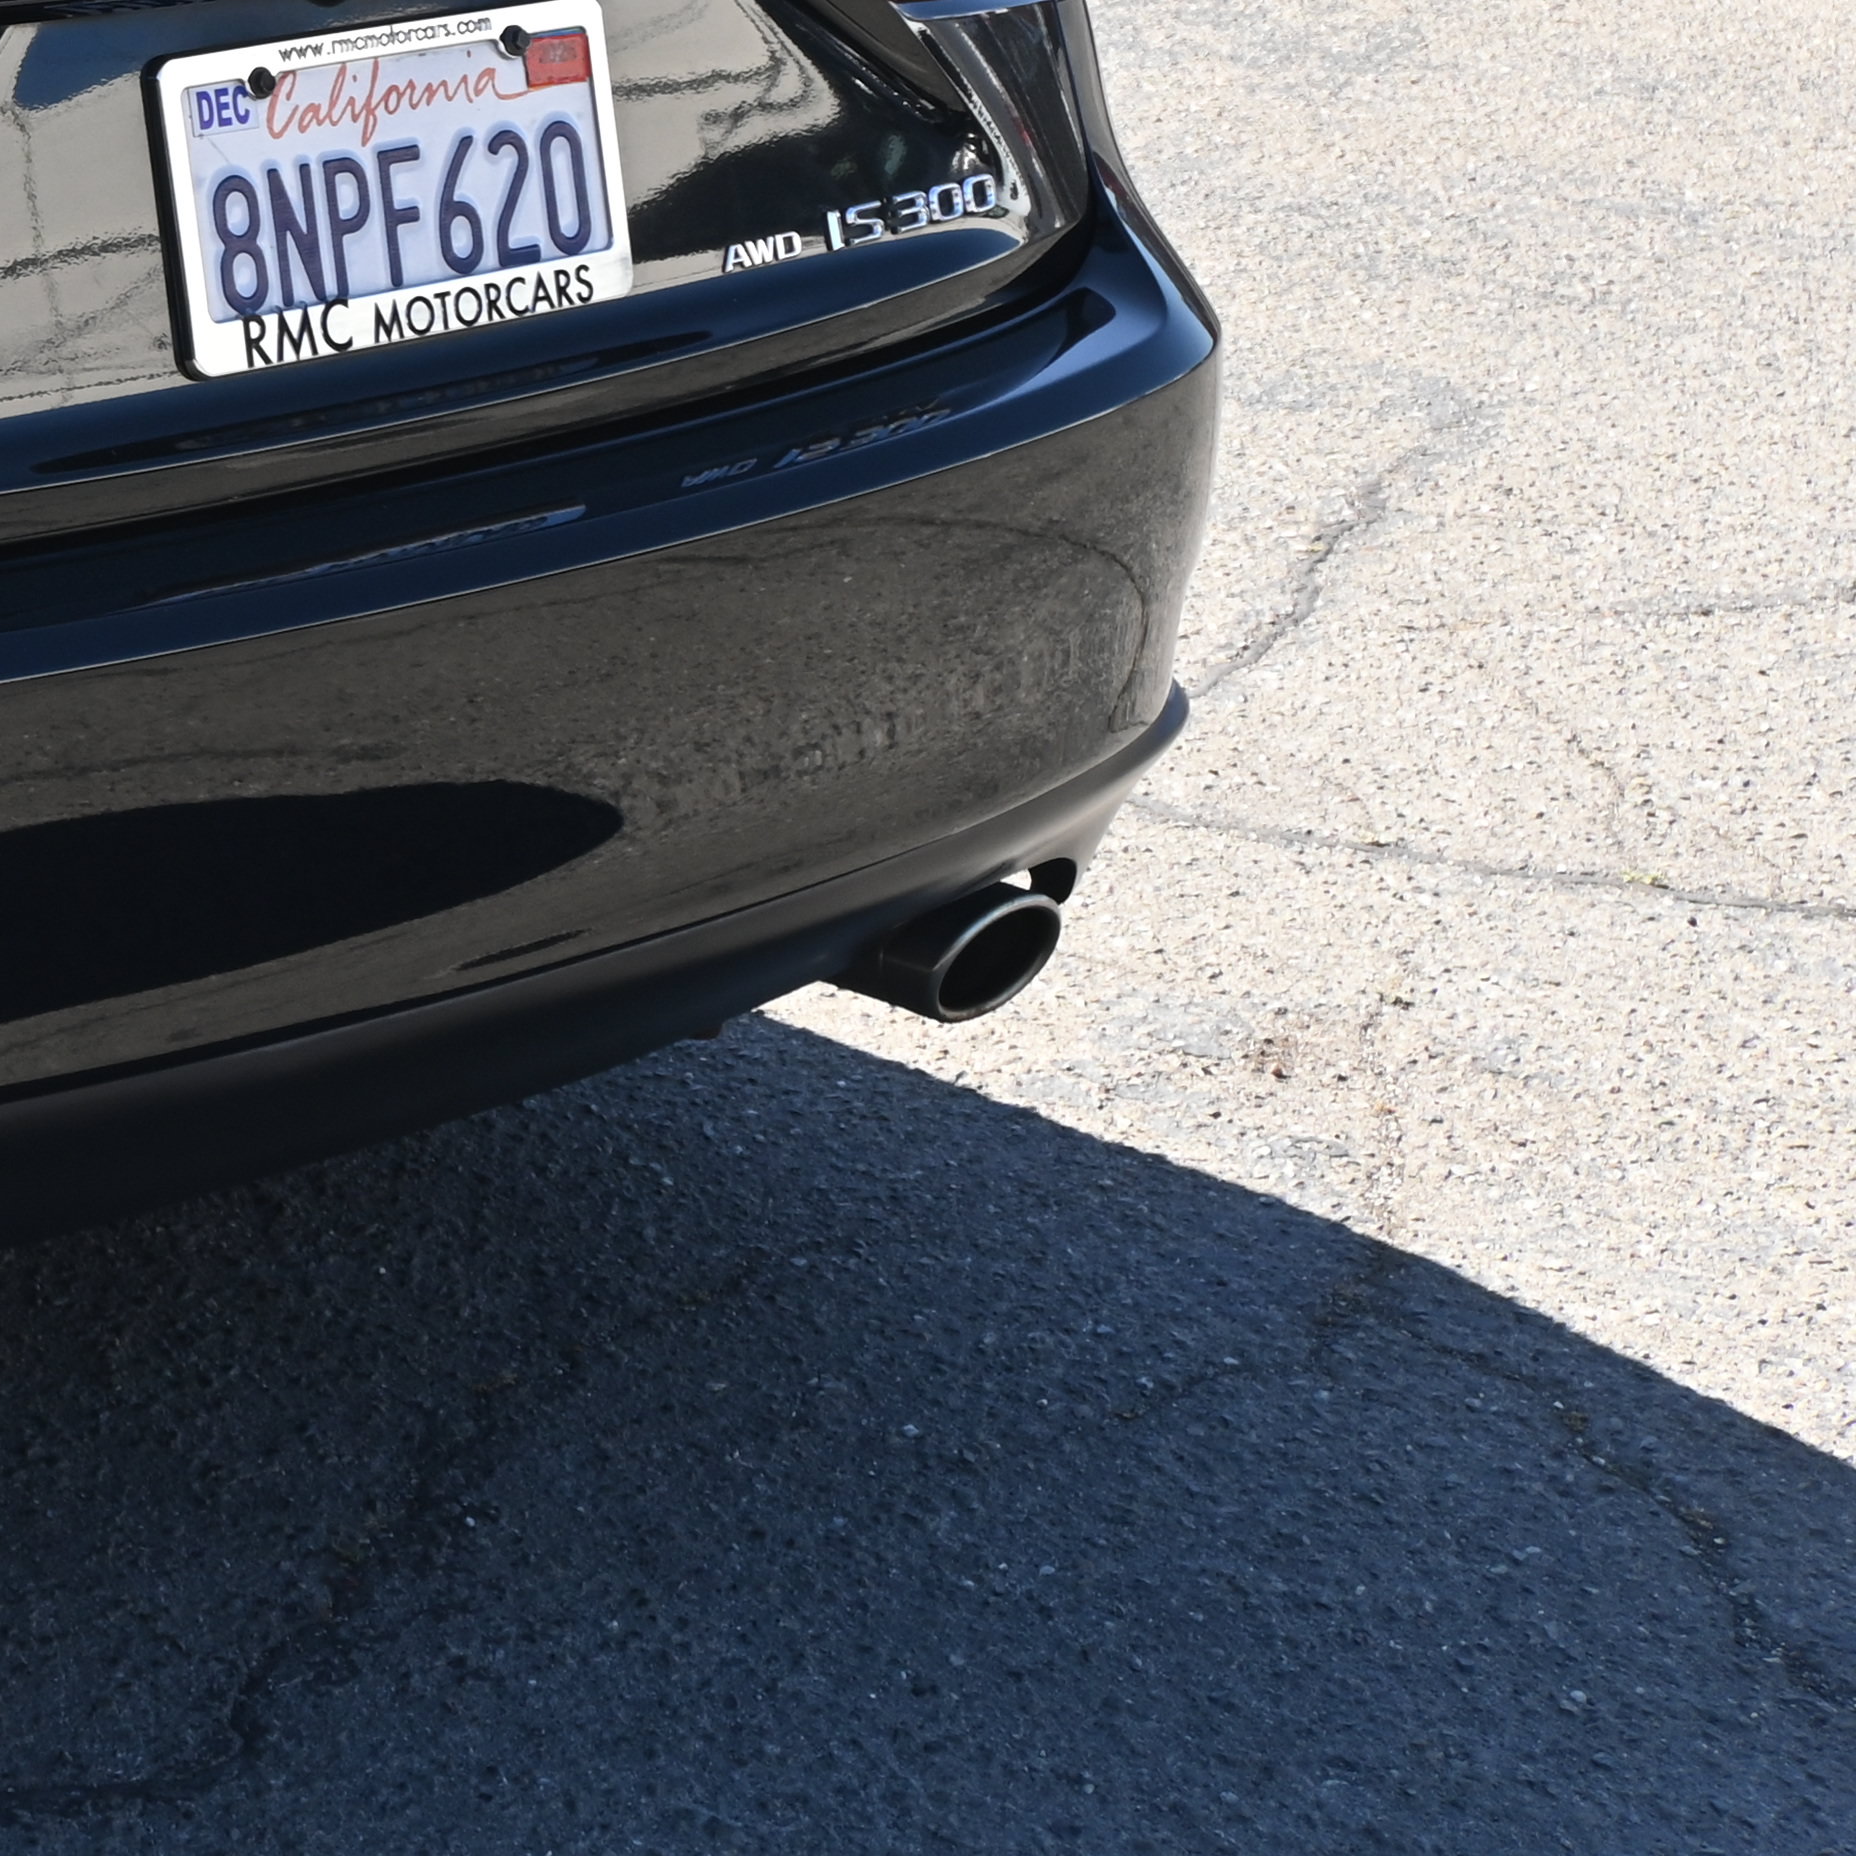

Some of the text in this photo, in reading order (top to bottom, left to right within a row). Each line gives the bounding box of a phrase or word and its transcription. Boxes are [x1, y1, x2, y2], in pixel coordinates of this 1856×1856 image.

[278, 17, 492, 63] www.rmcmotorcars.com
[196, 85, 251, 131] DEC
[266, 51, 532, 147] California
[212, 119, 592, 315] 8NPF620
[722, 230, 803, 273] AWD
[241, 264, 594, 369] RMC MOTORCARS
